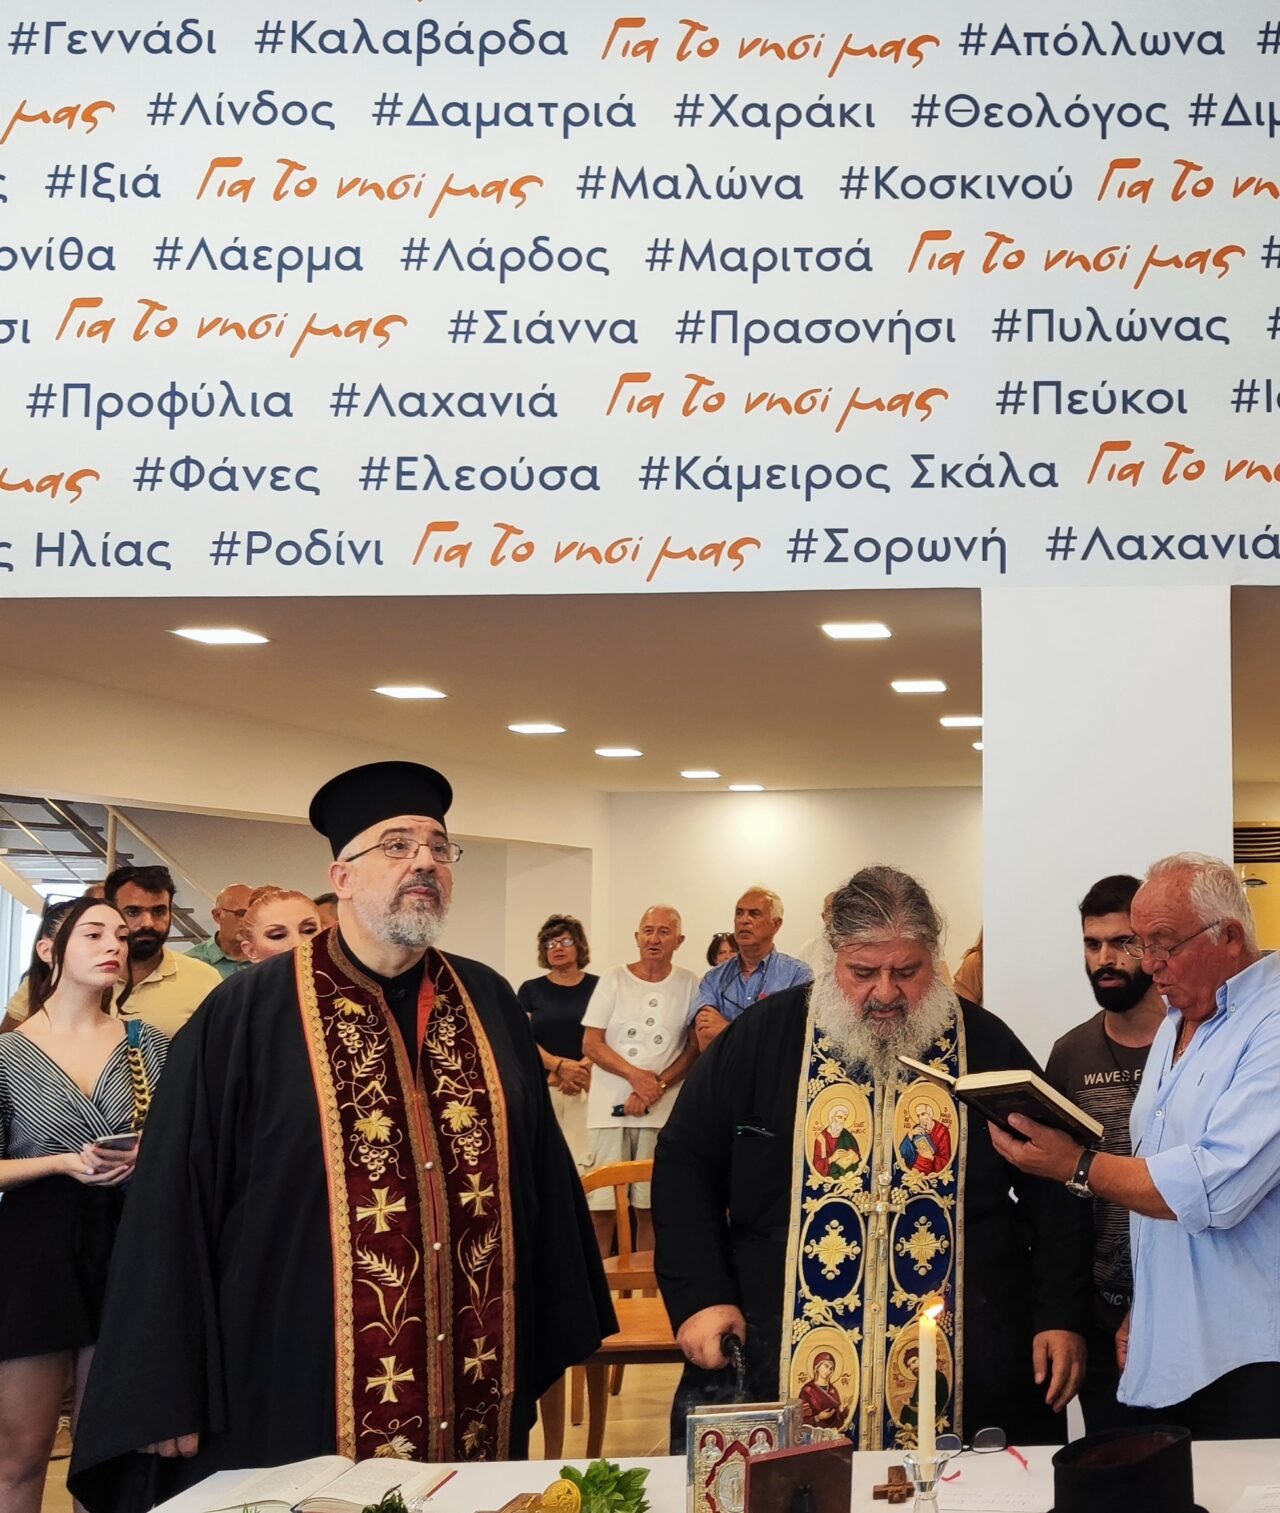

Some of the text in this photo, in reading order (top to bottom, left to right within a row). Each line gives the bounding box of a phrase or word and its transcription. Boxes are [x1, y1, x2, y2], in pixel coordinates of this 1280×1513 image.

[8, 19, 216, 55] #Γεννάδι
[255, 18, 568, 66] #Καλαβάρδα
[603, 17, 658, 62] Για
[676, 19, 720, 62] το
[738, 34, 822, 61] νησί
[828, 34, 940, 77] μας
[959, 21, 1225, 56] #Απόλλωνα
[0, 101, 115, 144] μας
[147, 90, 335, 130] #Λίνδος
[372, 93, 636, 139] #Δαματριά
[674, 94, 875, 140] #Χαράκι
[911, 92, 1169, 140] #Θεολόγος
[45, 162, 161, 202] #Ιξιά
[197, 156, 255, 201] Για
[273, 159, 318, 202] το
[337, 175, 422, 200] νησί
[429, 175, 544, 218] μας
[577, 164, 803, 199] #Μαλώνα
[840, 166, 1072, 199] #Κοσκινού
[1099, 157, 1153, 203] Για
[1171, 159, 1214, 202] το
[153, 237, 363, 283] #Λάερμα
[401, 236, 609, 283] #Λάρδος
[645, 238, 873, 284] #Μαριτσά
[909, 229, 965, 274] Για
[982, 231, 1025, 273] το
[1044, 246, 1128, 272] νησί
[1135, 245, 1246, 288] μας
[57, 297, 115, 343] Για
[132, 299, 179, 342] το
[197, 314, 284, 340] νησί
[291, 314, 408, 357] μας
[448, 310, 638, 344] #Σιάννα
[675, 310, 955, 356] #Πρασονήσι
[992, 306, 1230, 345] #Πυλώνας
[26, 380, 293, 430] #Προφύλια
[330, 383, 557, 417] #Λαχανιά
[608, 372, 664, 417] Για
[682, 374, 726, 417] το
[745, 388, 829, 416] νησί
[836, 388, 949, 432] μας
[996, 380, 1187, 415] #Πεύκοι
[133, 456, 320, 495] #Φάνες
[359, 454, 600, 491] #Ελεούσα
[639, 456, 890, 502] #Κάμειρος
[911, 451, 1058, 488] Σκάλα
[1088, 440, 1145, 487] Για
[1162, 441, 1206, 486] το
[36, 530, 171, 570] Ηλίας
[210, 529, 383, 565] #Ροδίνι
[413, 520, 472, 568] Για
[489, 522, 535, 567] το
[555, 538, 640, 565] νησί
[647, 536, 761, 579] μας
[787, 527, 1006, 575] #Σορωνή
[1084, 1070, 1131, 1086] WAVES
